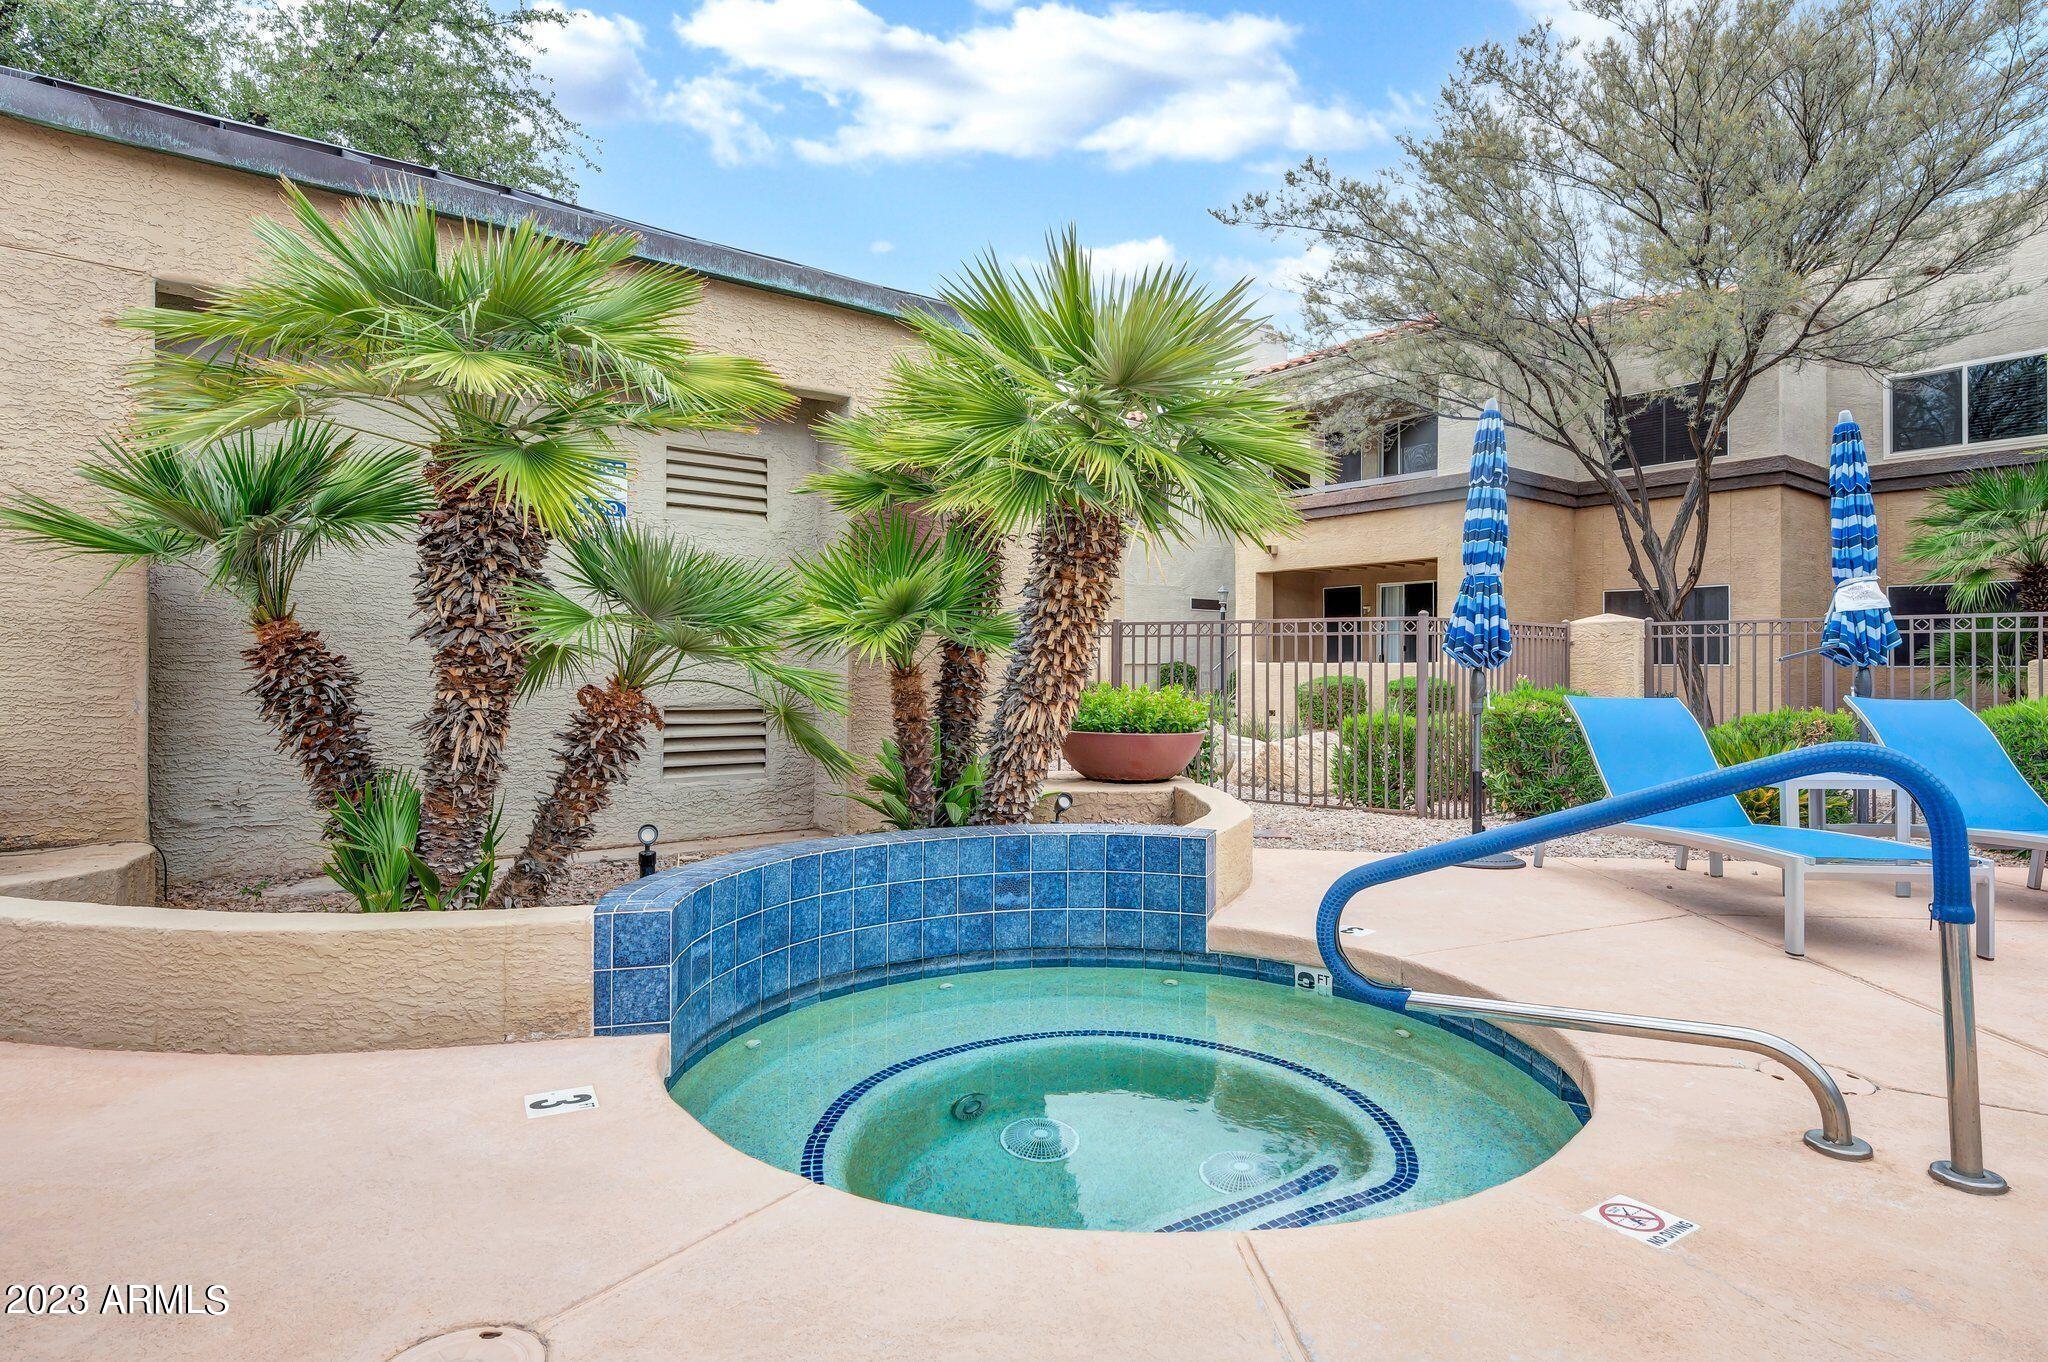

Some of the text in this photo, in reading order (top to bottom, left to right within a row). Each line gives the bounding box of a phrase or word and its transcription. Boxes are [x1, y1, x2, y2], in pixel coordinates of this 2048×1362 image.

[1317, 974, 1330, 986] FT
[529, 1094, 592, 1110] 3
[1646, 1220, 1693, 1247] NO DIVING
